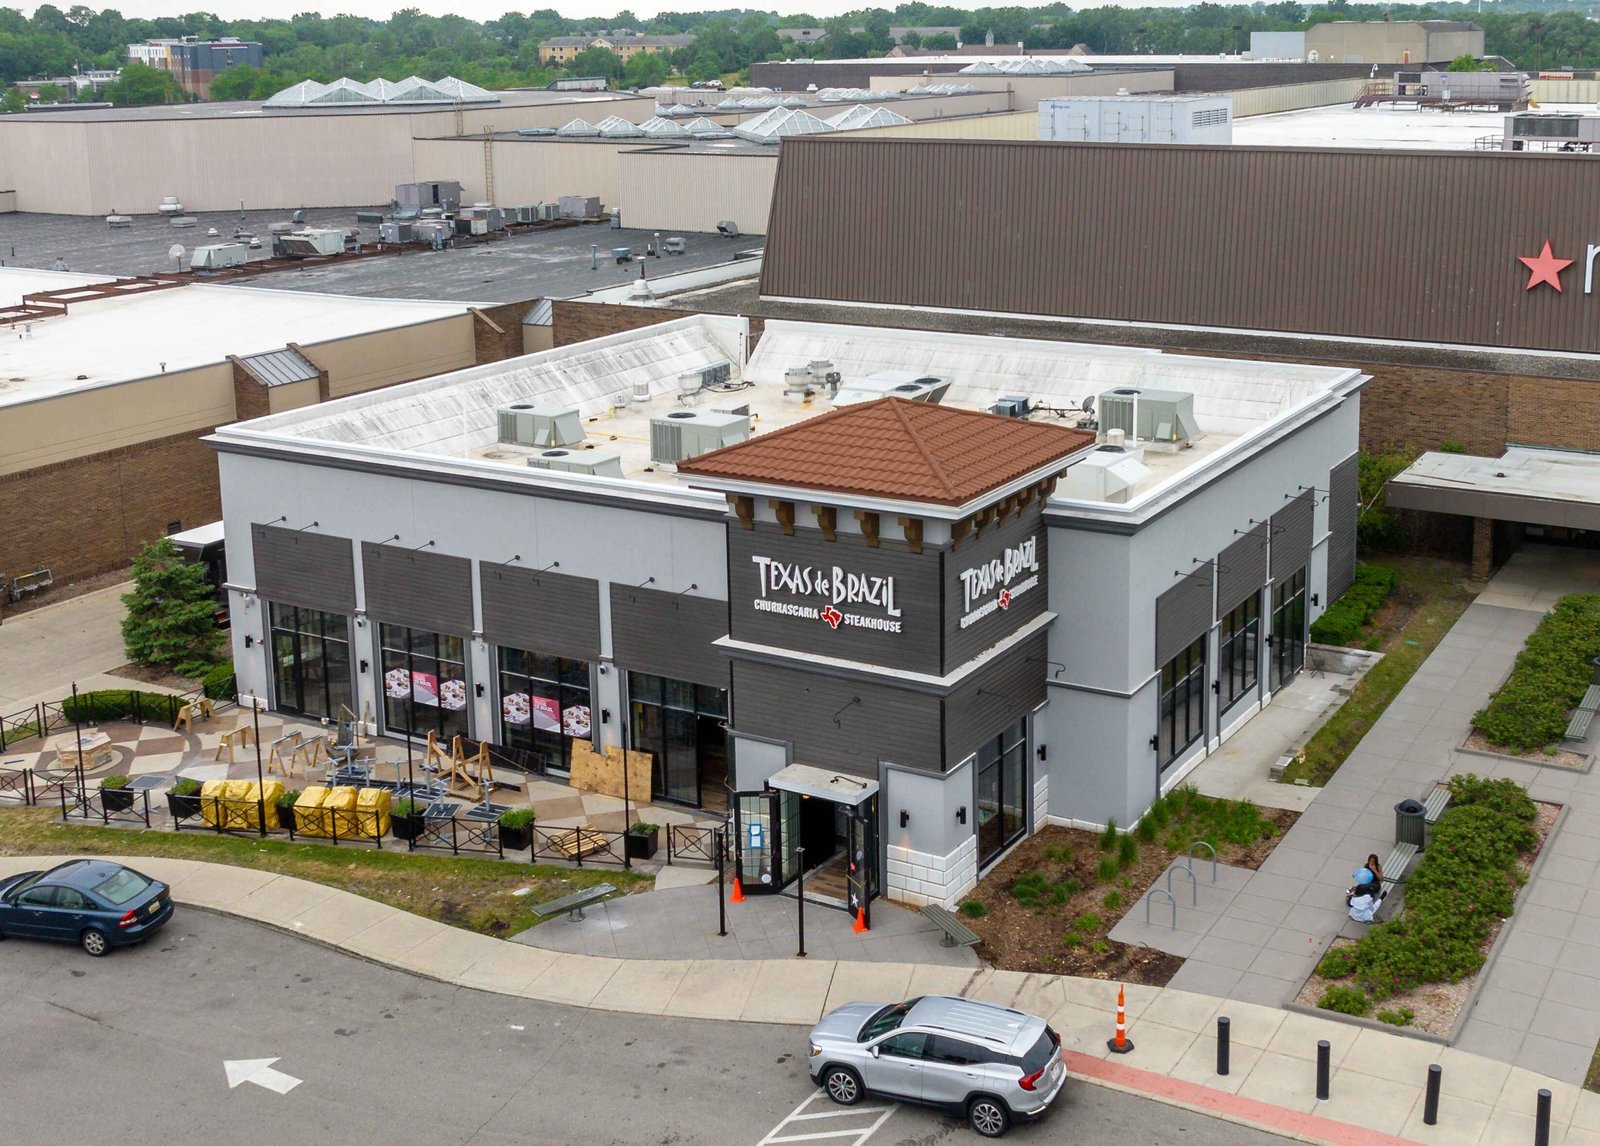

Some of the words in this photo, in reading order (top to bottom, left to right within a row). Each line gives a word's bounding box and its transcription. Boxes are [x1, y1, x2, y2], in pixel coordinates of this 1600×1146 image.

[752, 555, 812, 598] TEXAS
[814, 570, 830, 596] de
[960, 559, 996, 612] TEXAS
[754, 599, 819, 619] CHURRASCARIA
[843, 613, 902, 633] STEAKHOUSE
